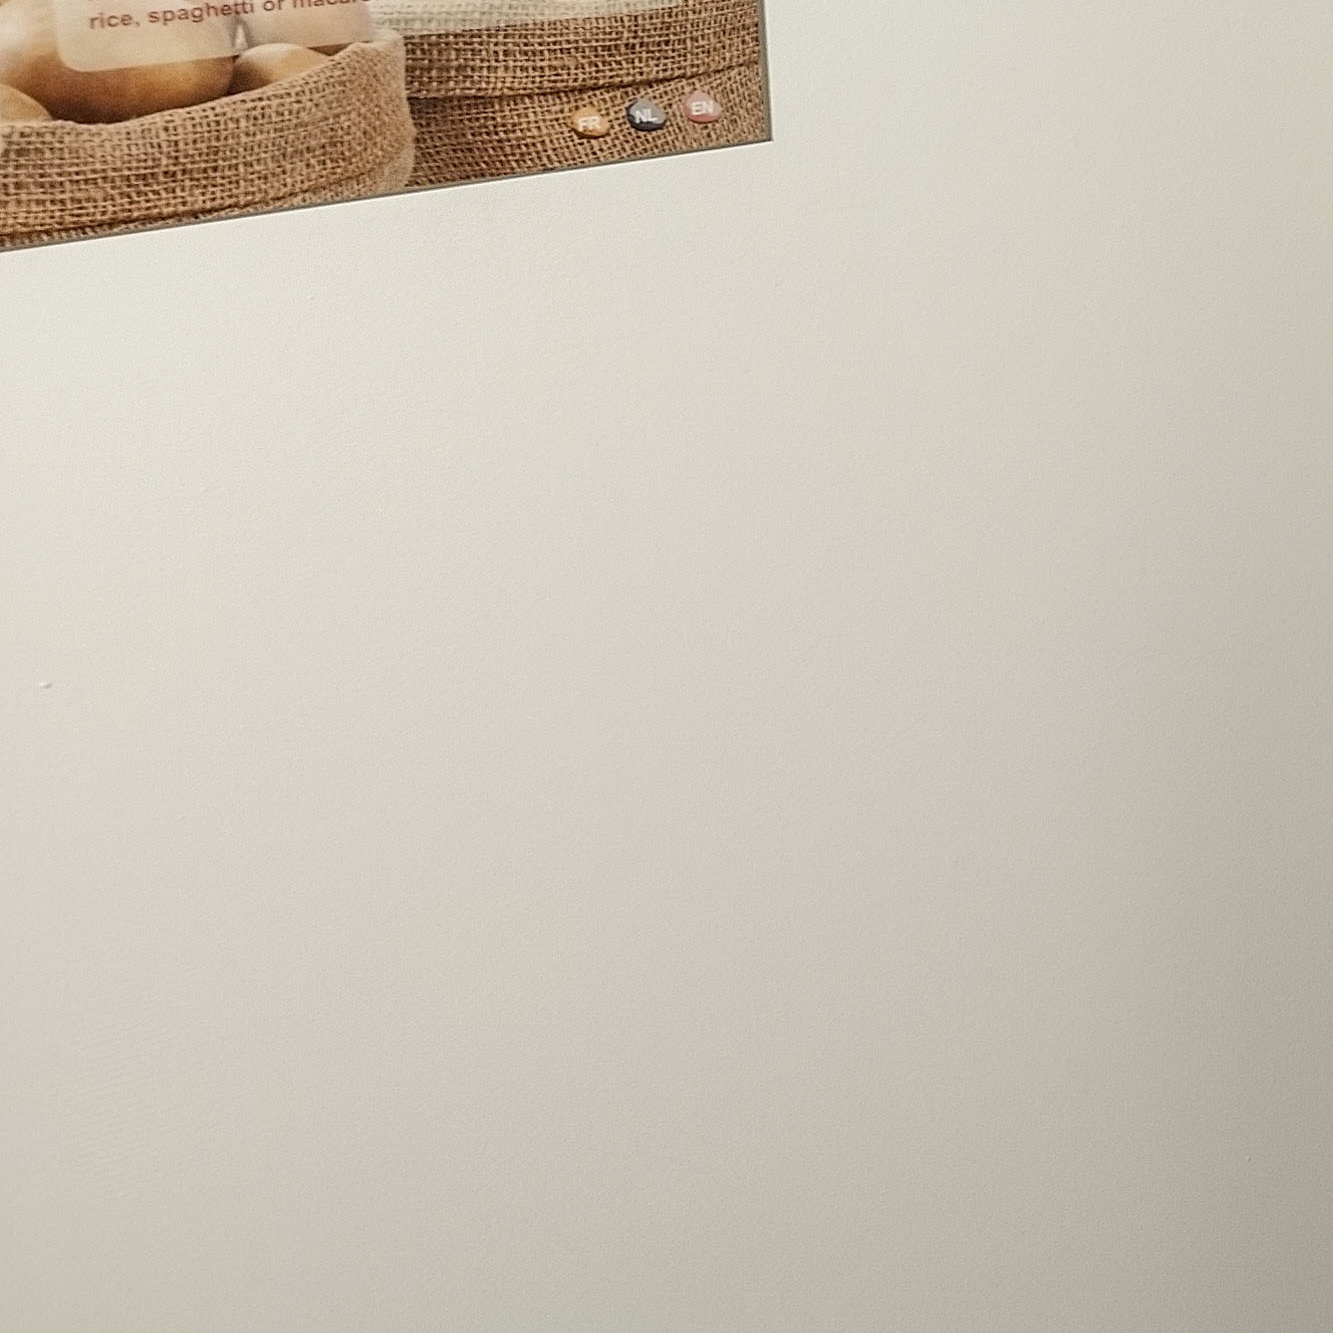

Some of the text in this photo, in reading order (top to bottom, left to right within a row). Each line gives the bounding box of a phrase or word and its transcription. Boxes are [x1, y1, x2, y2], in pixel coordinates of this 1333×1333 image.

[89, 12, 140, 29] rice,
[147, 0, 255, 26] spaghetti
[691, 100, 714, 116] EN
